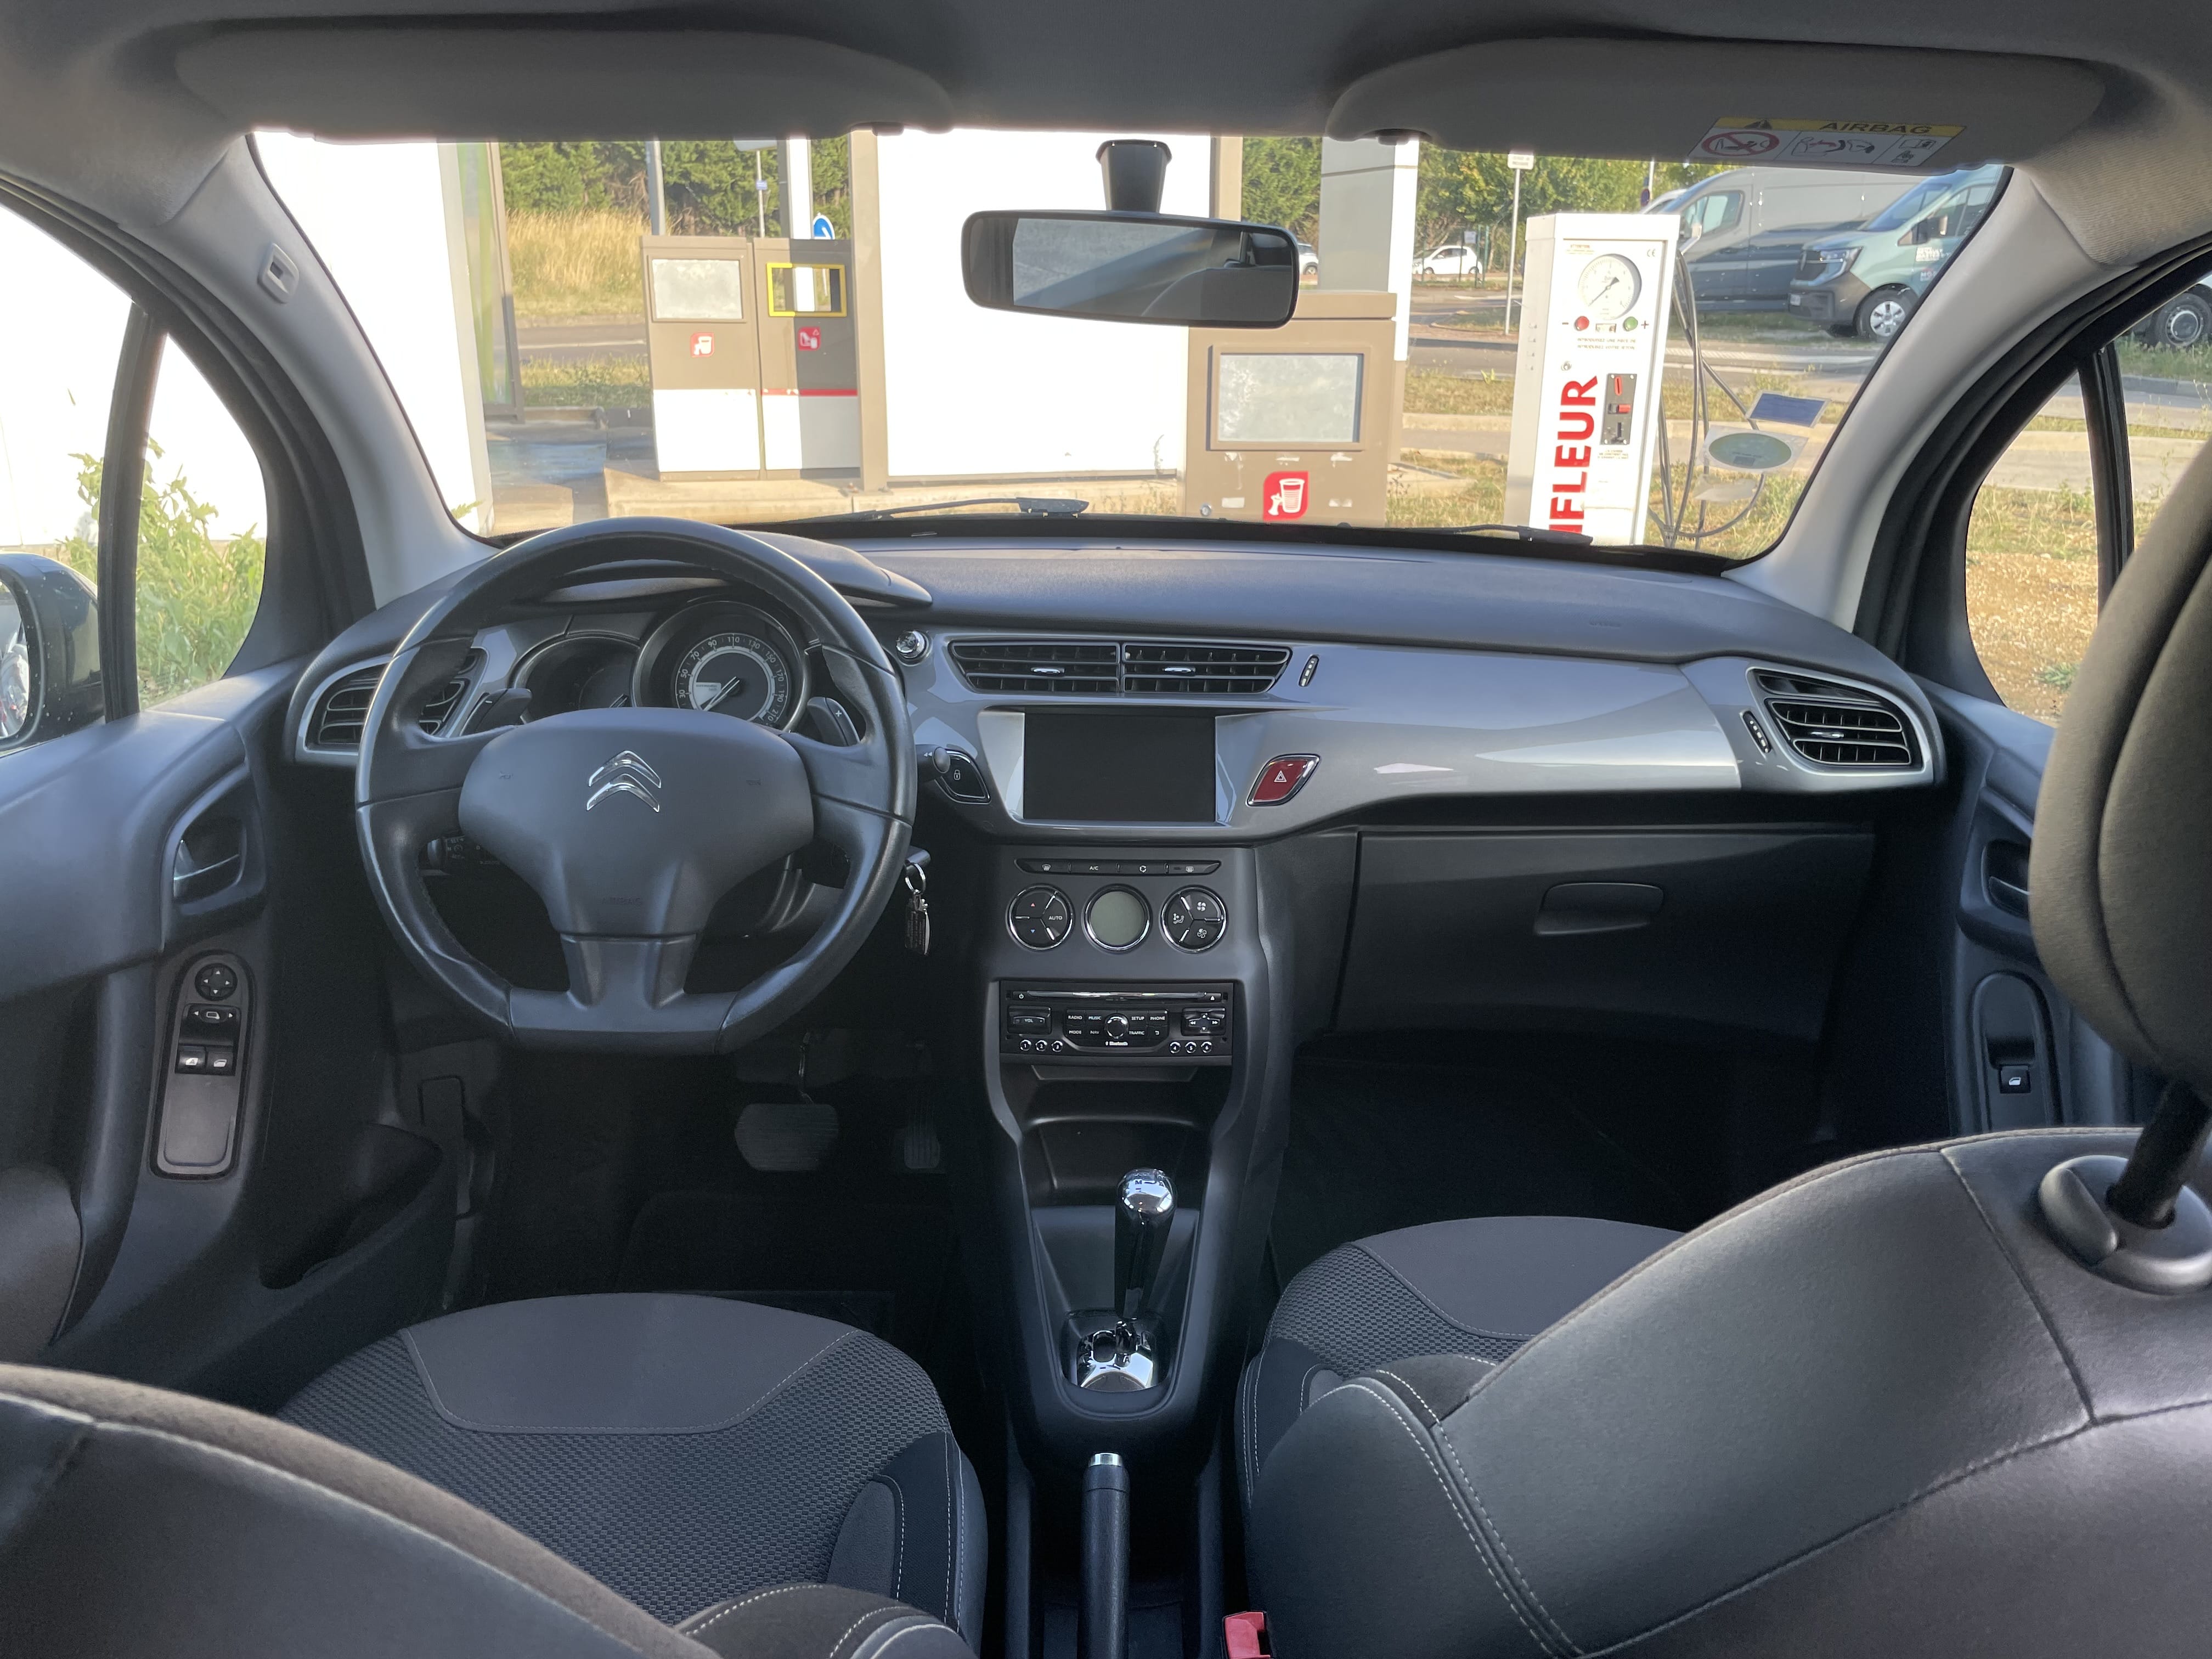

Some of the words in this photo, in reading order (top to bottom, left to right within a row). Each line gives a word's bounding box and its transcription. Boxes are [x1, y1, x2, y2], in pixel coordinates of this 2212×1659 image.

[1818, 122, 1932, 134] AIRBAG
[1549, 376, 1598, 534] FLEUR
[748, 639, 760, 650] 130
[691, 651, 699, 661] 70
[765, 651, 776, 663] 150
[680, 669, 689, 679] 50
[776, 669, 785, 682] 170
[679, 690, 686, 698] 30
[767, 709, 778, 721] 210
